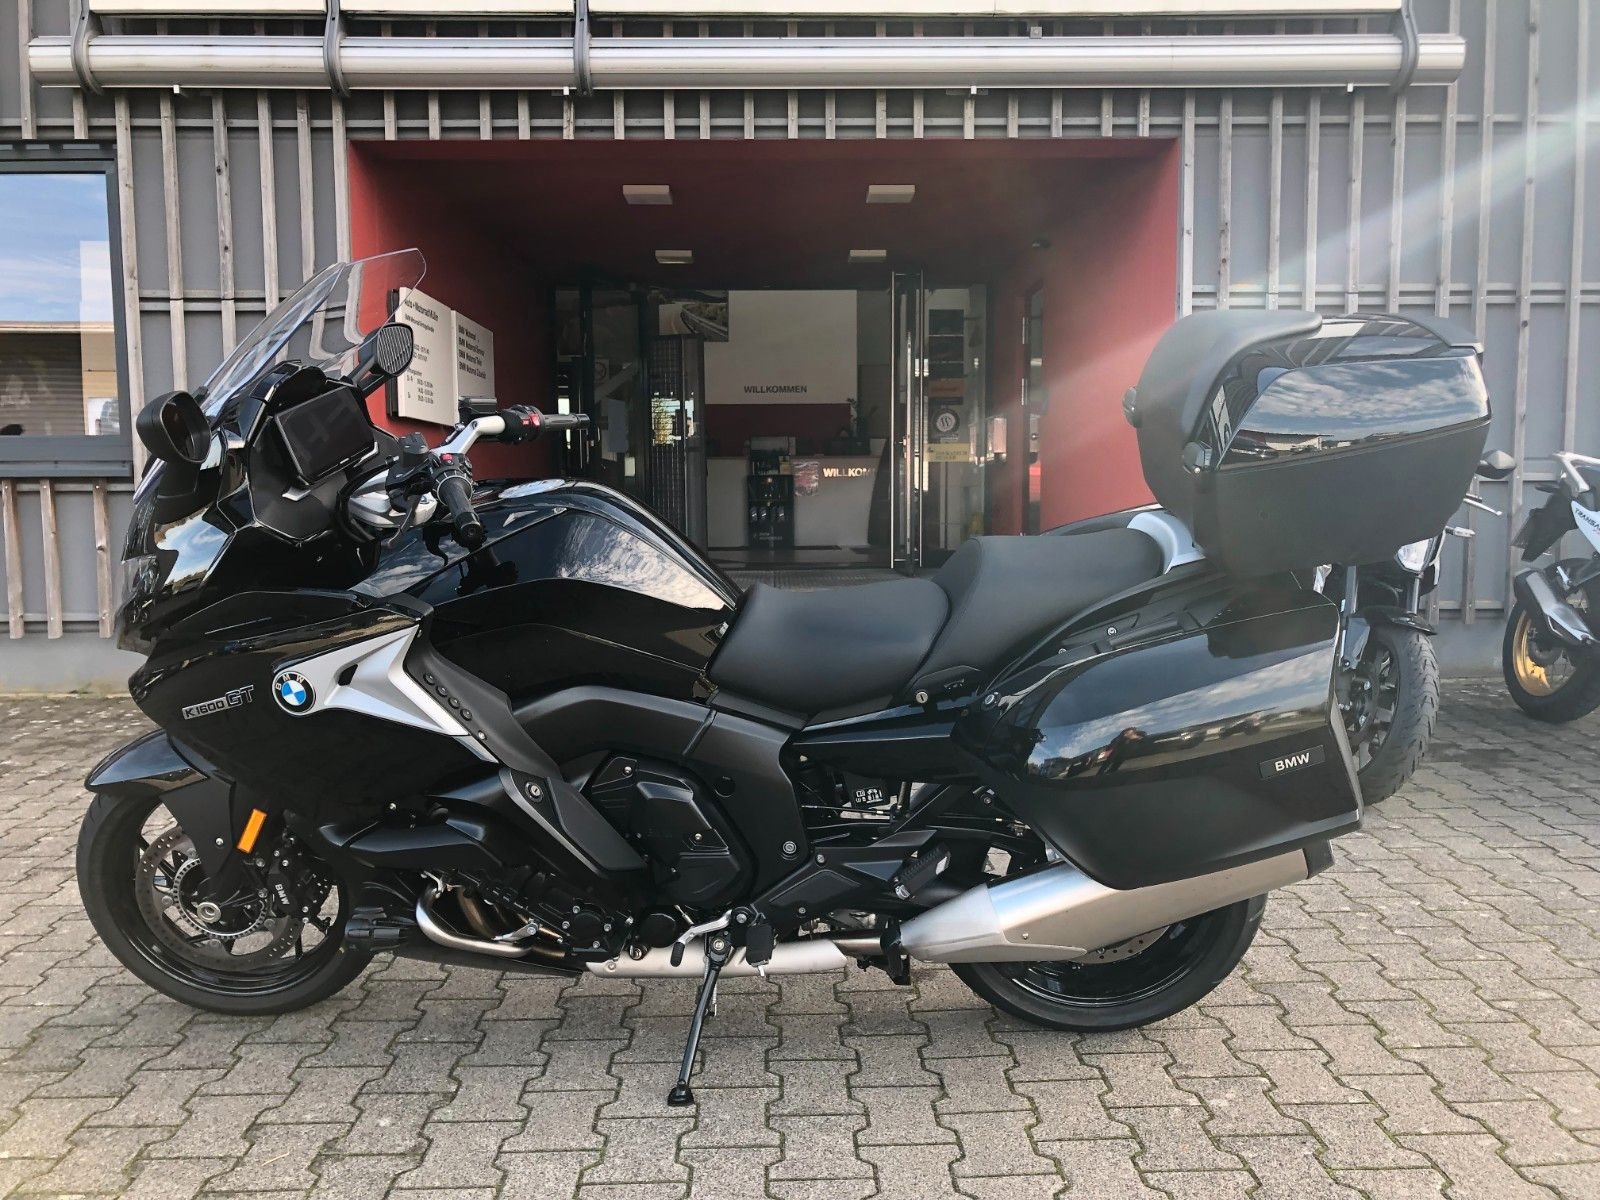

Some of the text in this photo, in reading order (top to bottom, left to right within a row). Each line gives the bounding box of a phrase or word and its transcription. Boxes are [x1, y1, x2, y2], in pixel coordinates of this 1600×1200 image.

[744, 385, 807, 394] WILLKOMMEN
[1575, 507, 1600, 525] TRANSA
[275, 673, 305, 691] BMW
[225, 684, 255, 707] GT
[1274, 752, 1310, 772] BMW
[275, 883, 290, 905] BMW
